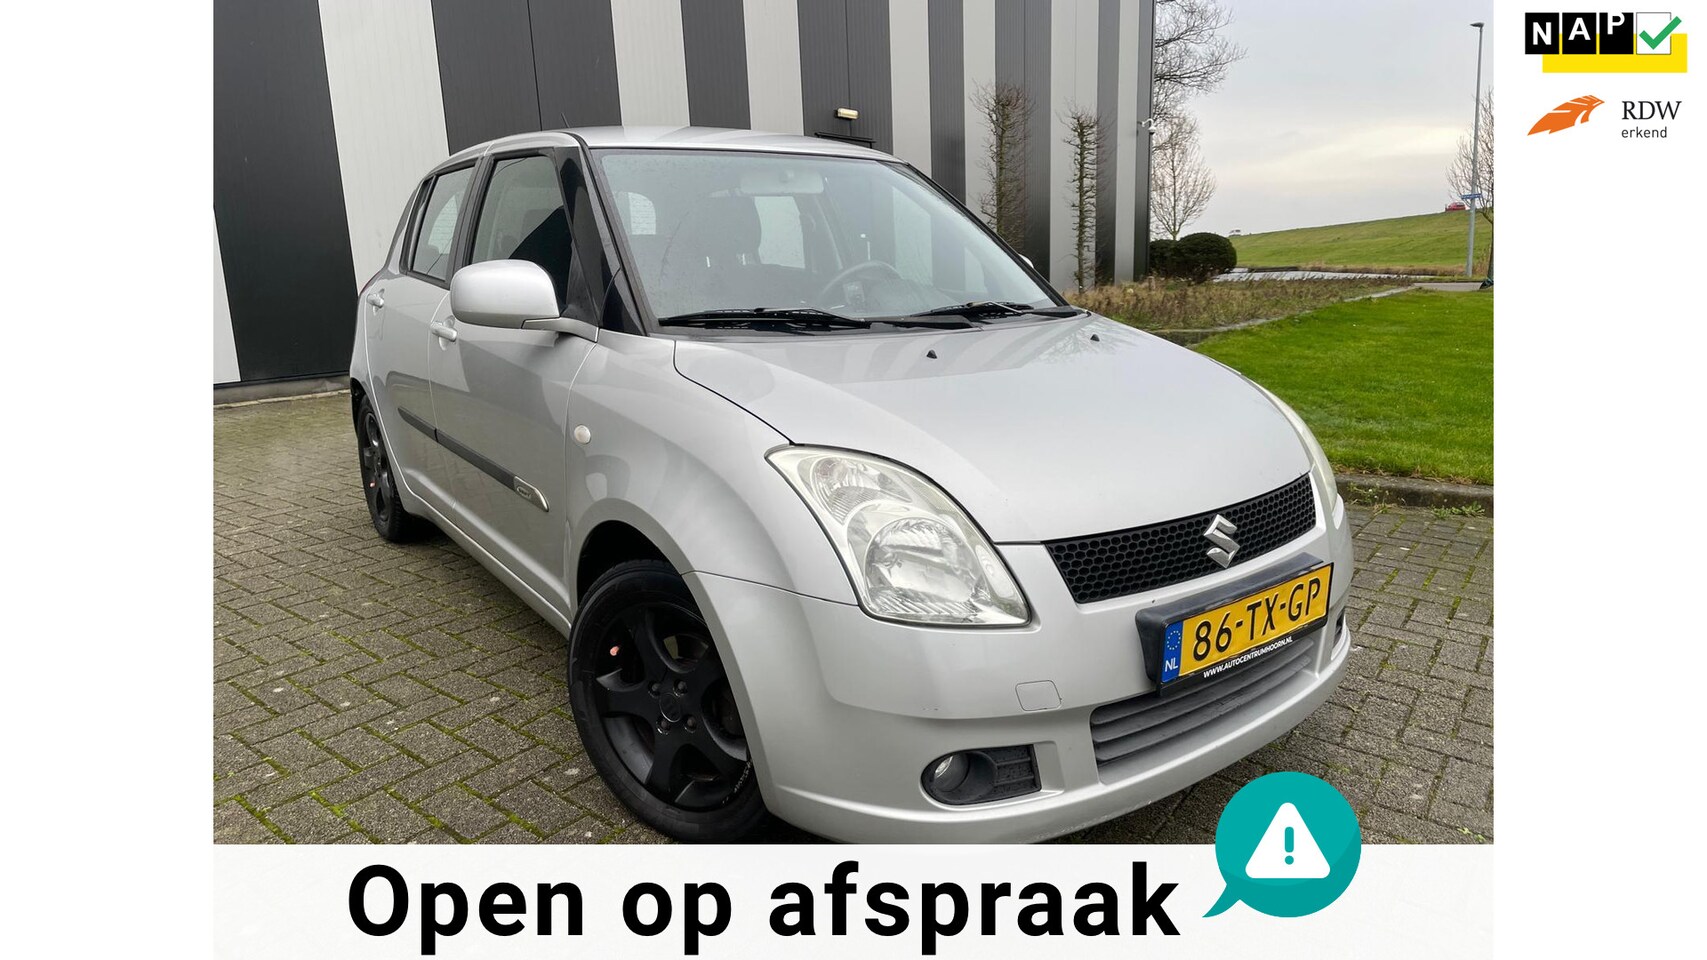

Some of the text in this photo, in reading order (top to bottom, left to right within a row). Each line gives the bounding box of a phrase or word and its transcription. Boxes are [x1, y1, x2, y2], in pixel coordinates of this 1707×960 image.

[1193, 577, 1321, 661] 86-TX-GP
[1164, 656, 1179, 672] NL
[1203, 635, 1293, 679] WWW.AUTOCENTRUMHOORN.NL
